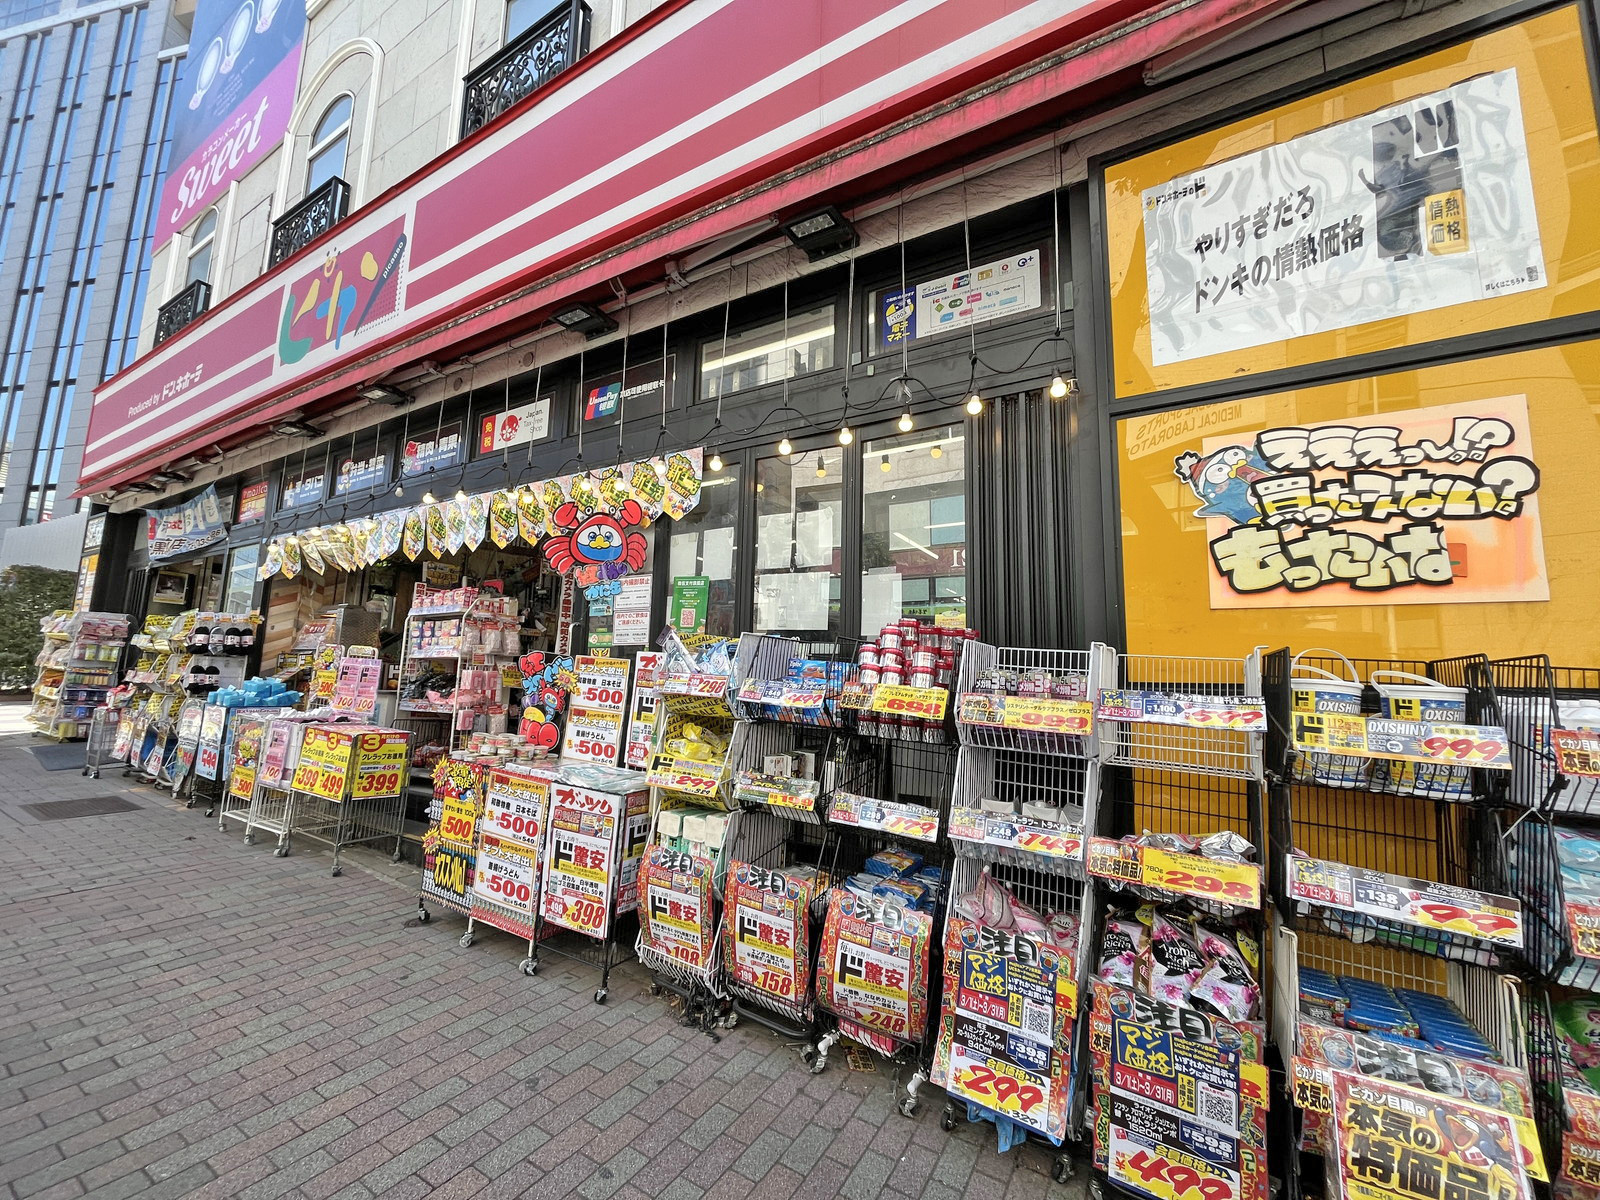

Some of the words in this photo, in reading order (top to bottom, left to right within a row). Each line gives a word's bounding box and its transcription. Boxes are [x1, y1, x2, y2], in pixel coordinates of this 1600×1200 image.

[1429, 197, 1461, 221] 情熱
[1194, 185, 1315, 263] やりすぎだろ
[1430, 220, 1461, 245] 価格
[1195, 213, 1365, 314] ドンキの情熱価格
[484, 421, 493, 447] 免税
[1210, 522, 1454, 595] もったいな
[585, 688, 623, 704] 500
[698, 680, 726, 694] 298
[337, 697, 353, 707] 100
[357, 700, 373, 709] 100
[887, 699, 942, 715] 698
[1021, 712, 1089, 729] 999
[1368, 720, 1428, 736] OXISHINY
[578, 740, 616, 758] 500
[1424, 737, 1503, 761] 999
[265, 765, 280, 779] 100
[297, 767, 320, 788] 399
[361, 772, 399, 793] 399
[238, 779, 252, 794] 500
[321, 773, 344, 795] 499
[556, 788, 613, 815] ガッツリ
[445, 816, 472, 839] 500
[499, 812, 539, 837] 500
[1023, 833, 1081, 854] 149
[489, 875, 530, 901] 500
[1165, 870, 1254, 900] 298
[1367, 889, 1398, 905] 138
[571, 900, 606, 929] 398
[1420, 904, 1518, 933] 99
[968, 954, 1001, 973] マジ
[762, 971, 792, 996] 158
[970, 971, 1005, 994] 価格
[868, 1011, 906, 1032] 248
[963, 1023, 1001, 1041] ハミングフレア
[967, 1040, 992, 1055] 940ml
[1120, 1023, 1163, 1049] マジ
[1015, 1042, 1047, 1061] 398
[1125, 1044, 1172, 1076] 価格
[986, 1058, 1026, 1081] 会員価格
[963, 1065, 1044, 1113] 299
[1133, 1102, 1157, 1116] ライオン
[1347, 1084, 1428, 1118] ピカソ目黒店
[1125, 1113, 1177, 1139] ウルトラジャンボ
[1128, 1121, 1164, 1142] 1520ml
[1347, 1101, 1438, 1151] 本気の
[1191, 1131, 1233, 1153] 598
[1154, 1144, 1207, 1173] 会員価格
[1349, 1132, 1491, 1200] 特価品
[1128, 1150, 1233, 1200] 499
